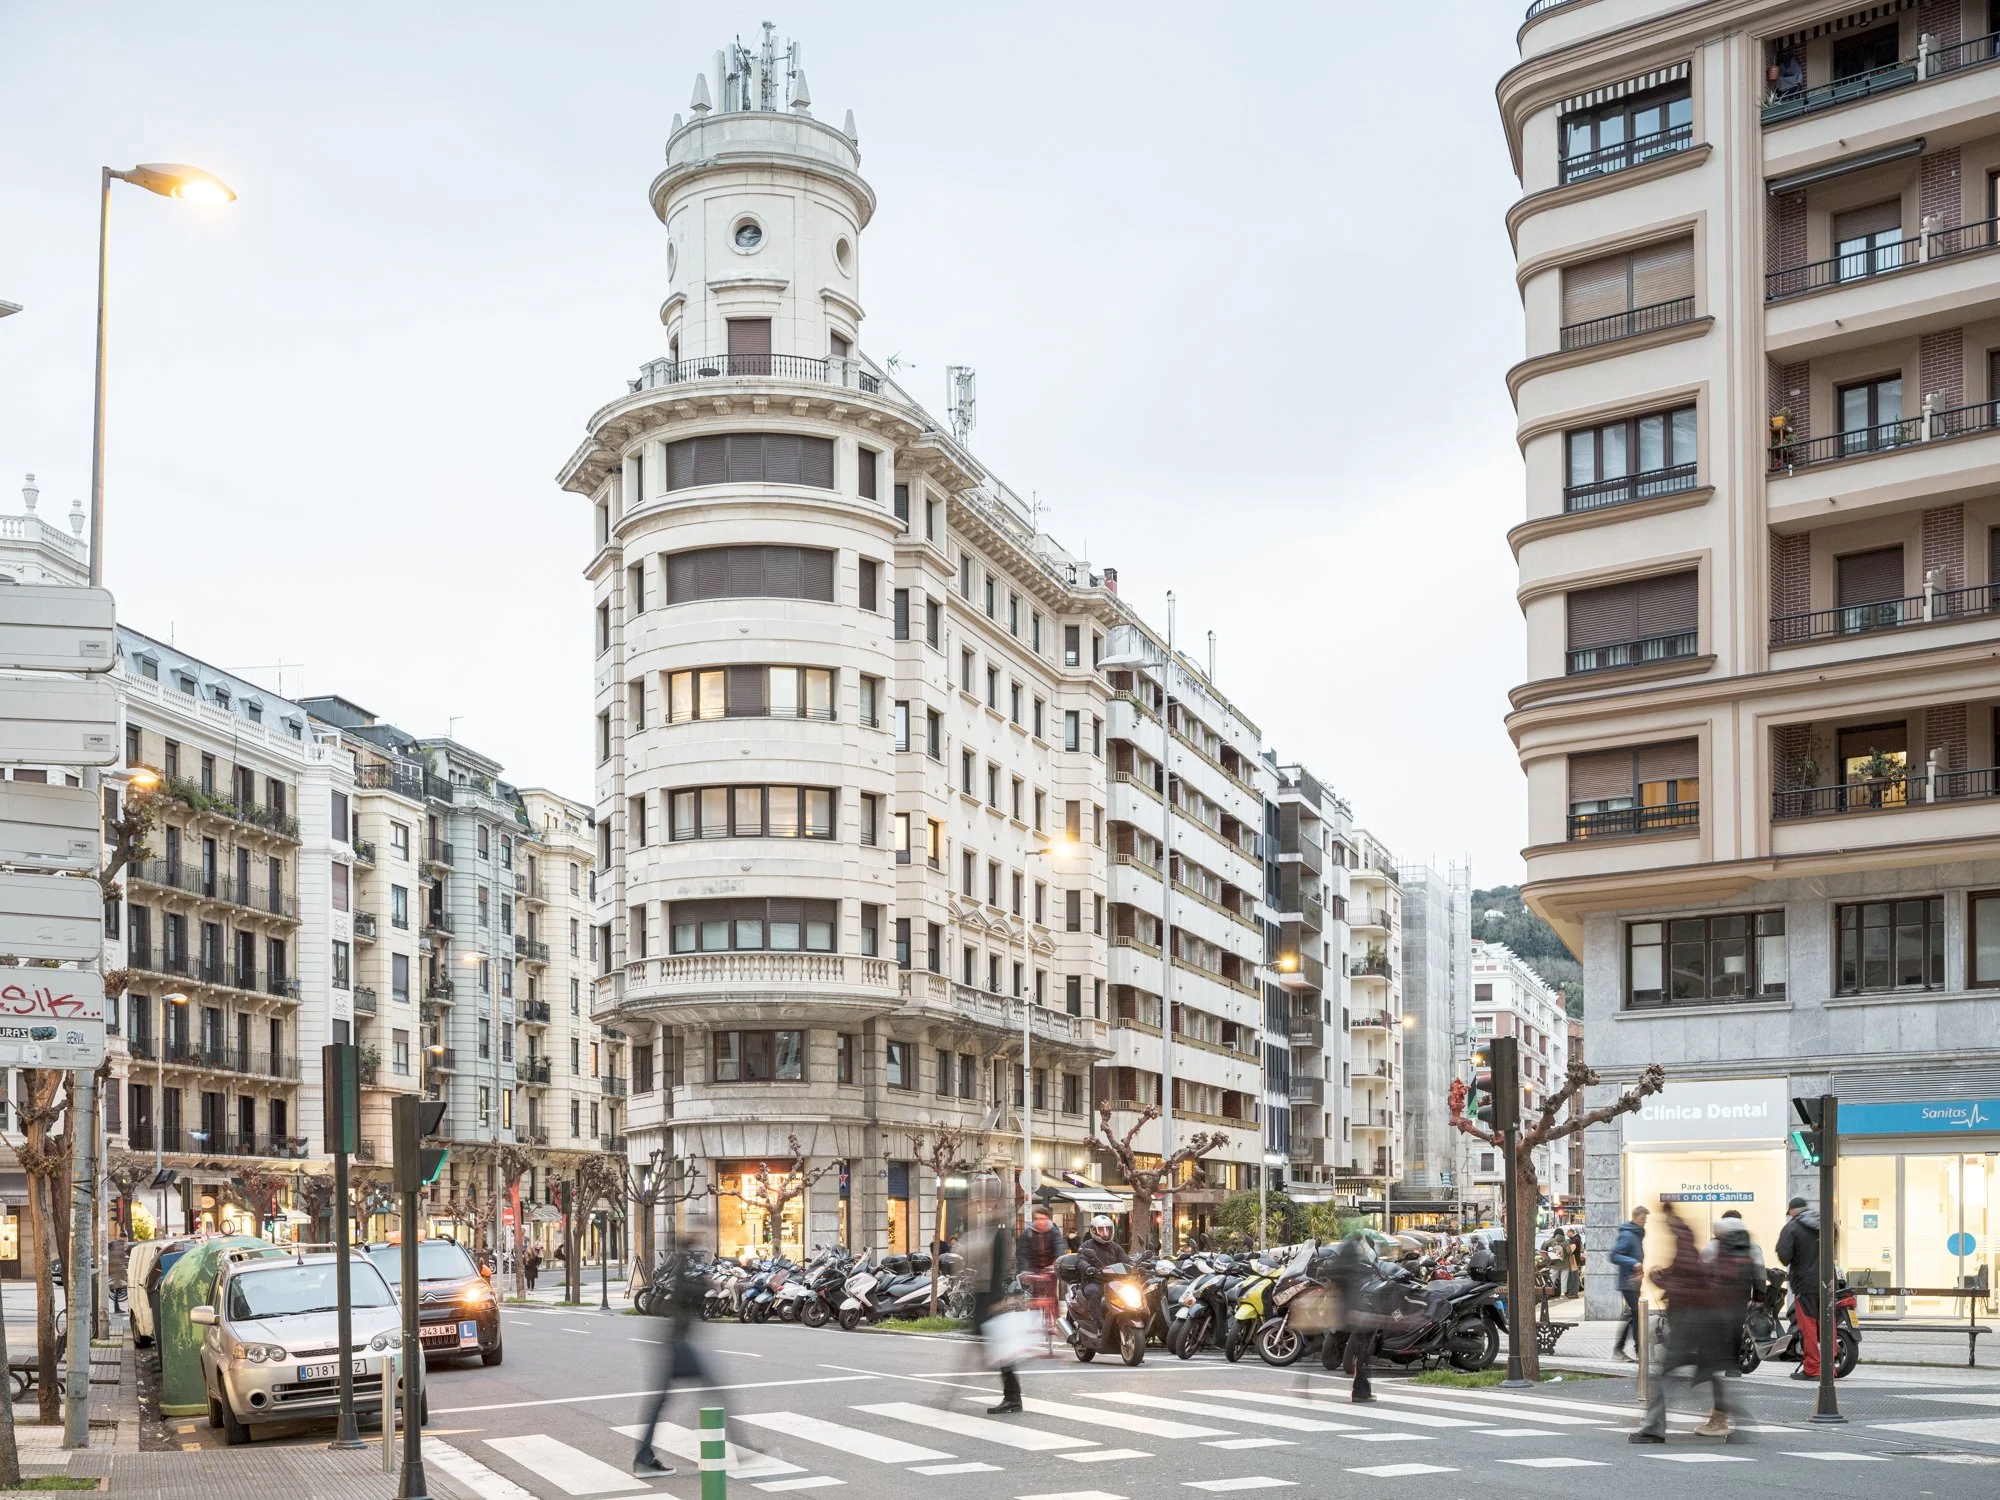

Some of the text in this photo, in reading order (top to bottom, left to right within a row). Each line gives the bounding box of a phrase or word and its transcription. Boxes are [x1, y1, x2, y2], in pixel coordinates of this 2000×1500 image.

[1642, 1102, 1767, 1120] Clínica Dental
[1922, 1108, 1967, 1118] Sanitas
[1681, 1183, 1732, 1191] Para todos,
[1691, 1193, 1702, 1201] no
[1705, 1193, 1717, 1201] de
[1719, 1192, 1753, 1201] Sanitas
[463, 1324, 472, 1336] L
[306, 1364, 335, 1378] 0181
